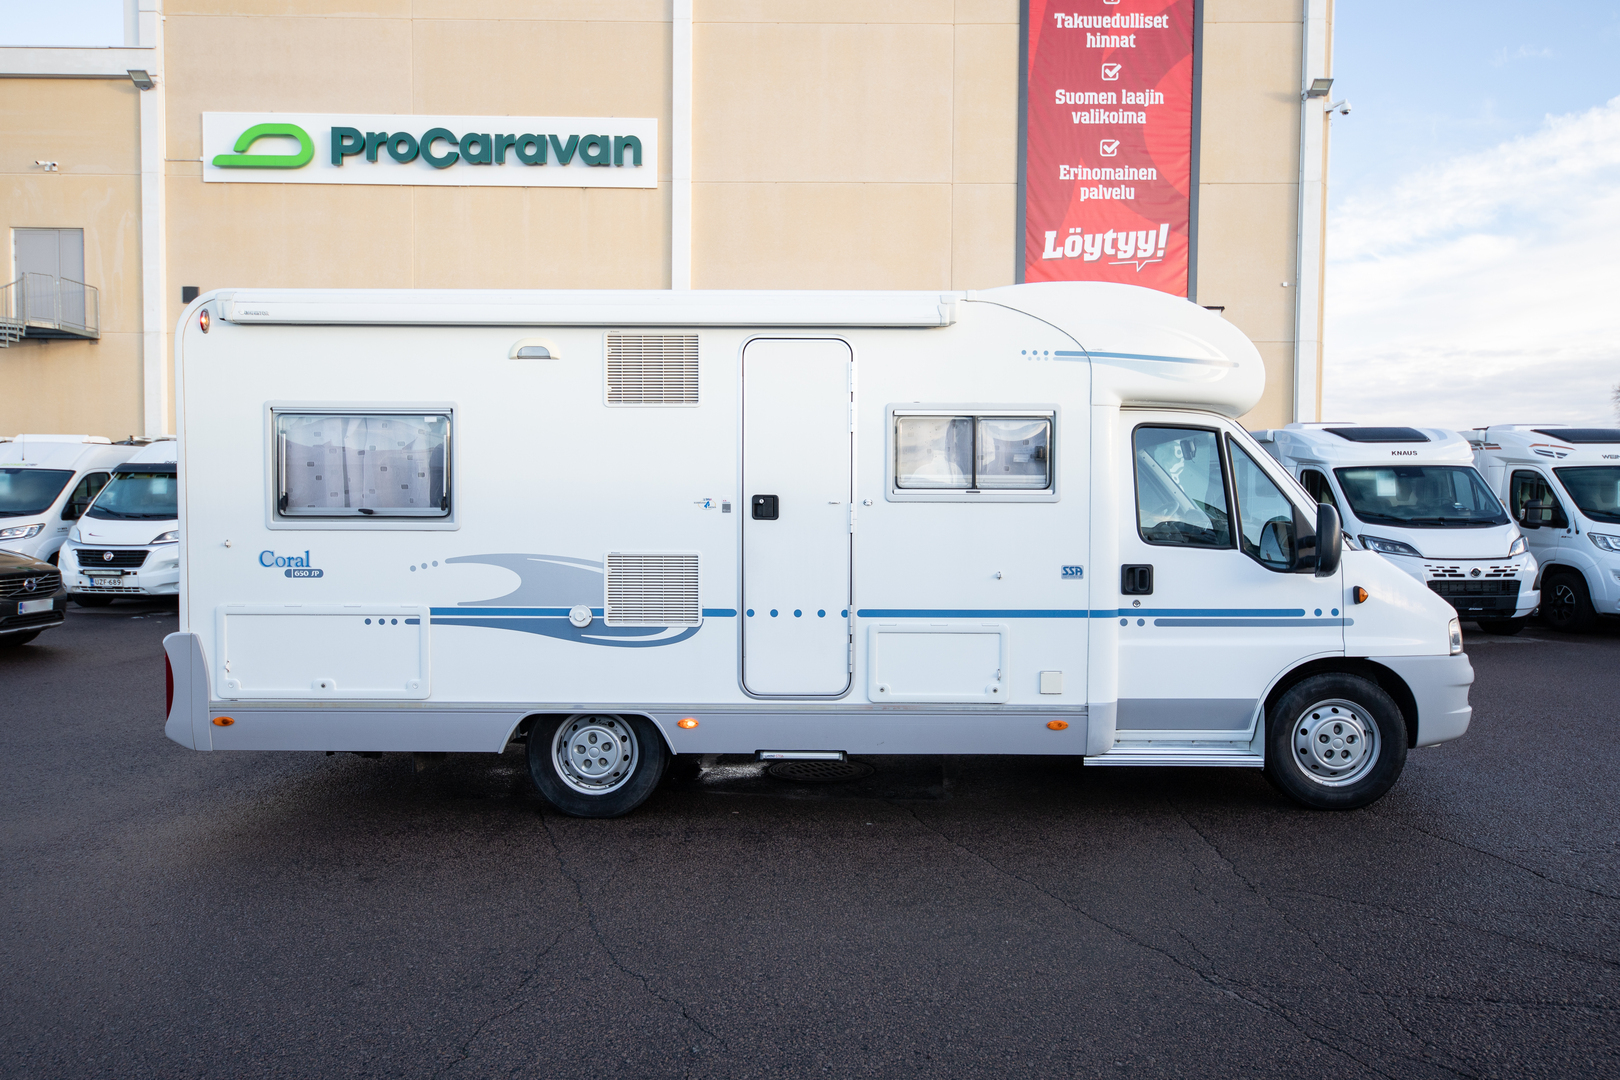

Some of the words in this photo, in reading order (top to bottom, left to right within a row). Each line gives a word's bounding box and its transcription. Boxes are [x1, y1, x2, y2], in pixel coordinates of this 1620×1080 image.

[1054, 13, 1169, 29] Takuuedulliset
[1086, 32, 1136, 48] hinnat
[1055, 89, 1117, 105] Suomen
[1121, 89, 1164, 107] laajin
[1072, 109, 1146, 124] valikoima
[331, 126, 643, 169] ProCaravan
[1059, 165, 1157, 181] Erinomainen
[1080, 184, 1135, 202] palvelu
[1042, 223, 1170, 262] Löytyy!
[258, 549, 312, 568] Coral
[1062, 566, 1083, 576] SSA
[94, 578, 122, 586] UZF-689
